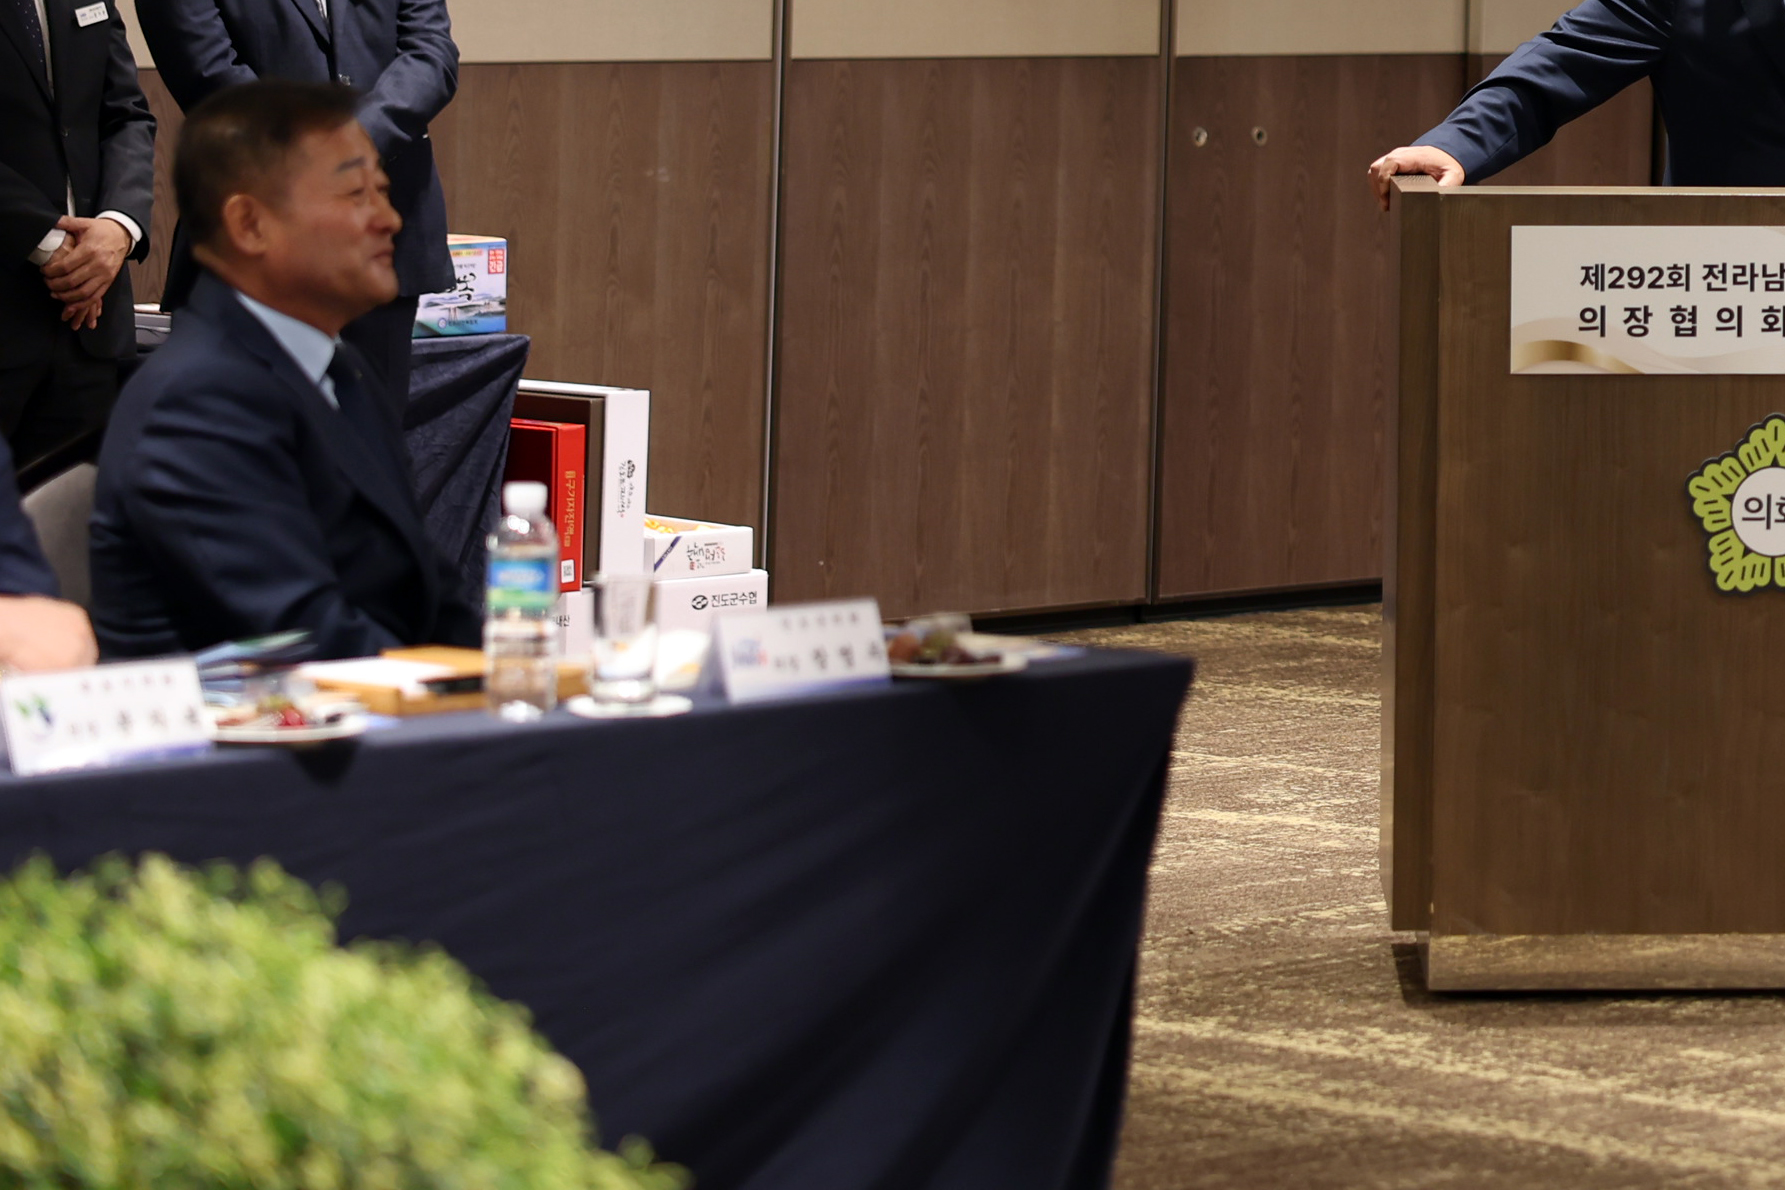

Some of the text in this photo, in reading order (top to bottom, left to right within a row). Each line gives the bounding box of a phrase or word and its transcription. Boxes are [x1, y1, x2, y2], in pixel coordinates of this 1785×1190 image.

[1579, 263, 1692, 292] 제292회
[711, 591, 758, 608] 진도군수협
[553, 615, 571, 628] 내산
